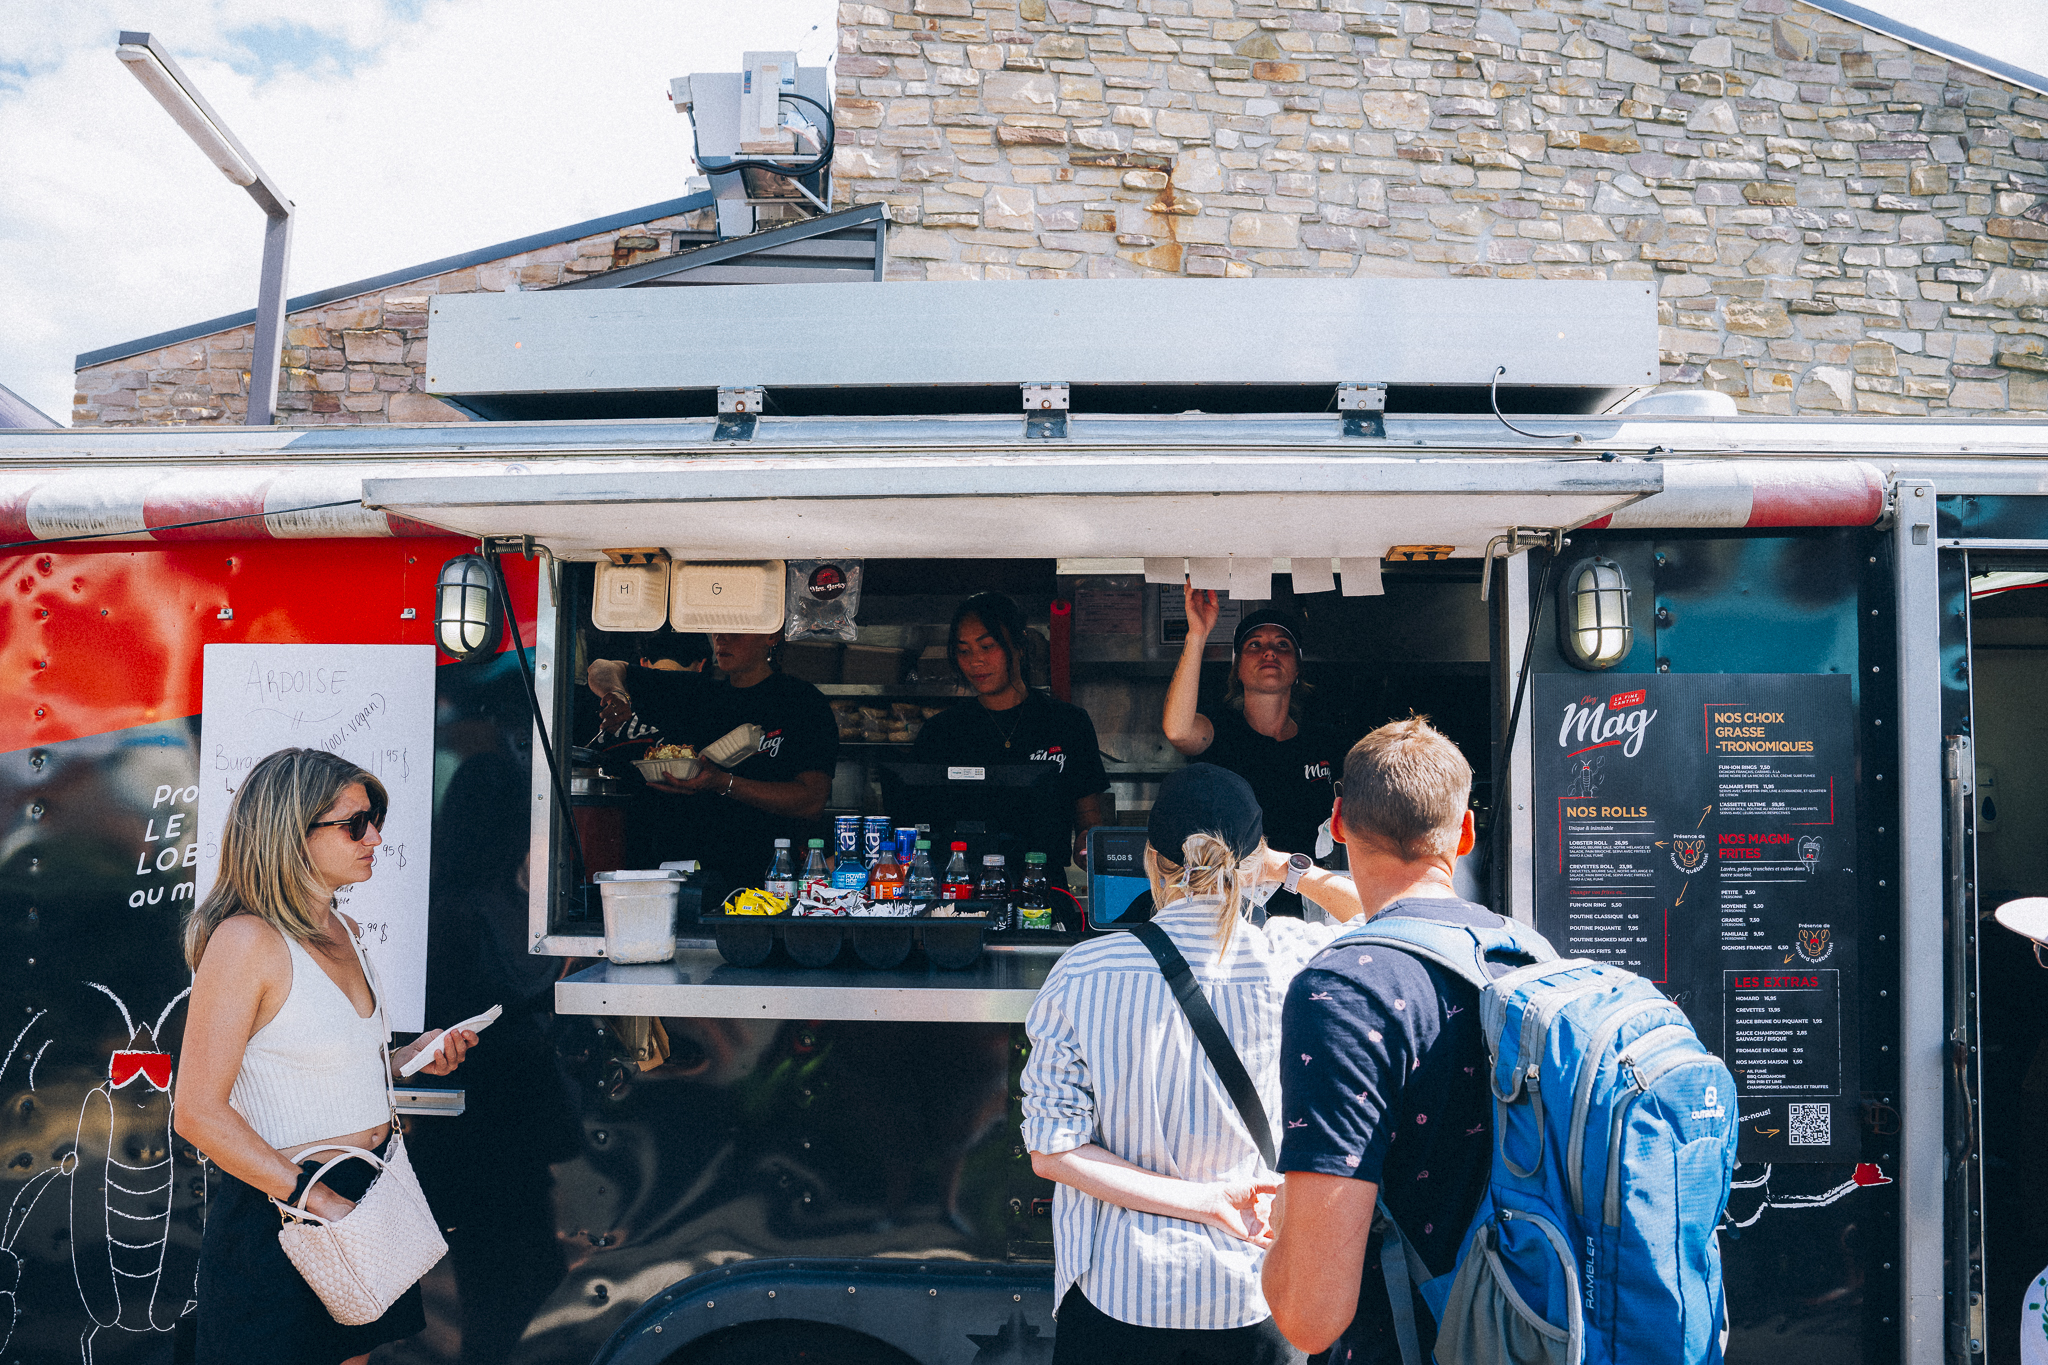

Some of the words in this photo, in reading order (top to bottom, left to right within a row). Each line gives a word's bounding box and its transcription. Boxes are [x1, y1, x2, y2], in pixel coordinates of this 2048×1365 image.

[621, 584, 629, 594] H
[712, 583, 722, 595] G
[246, 660, 349, 703] ARDOISE
[1715, 713, 1742, 723] NOS
[1744, 713, 1785, 723] CHOIX
[1559, 703, 1657, 757] Mag
[1715, 727, 1766, 737] GRASSE
[758, 735, 784, 757] ag
[1716, 741, 1814, 752] -TRONOMIQUES
[1567, 806, 1597, 818] NOS
[1602, 806, 1648, 818] ROLLS
[145, 814, 185, 842] LE
[1719, 834, 1745, 844] NOS
[1749, 834, 1794, 844] MAGNI-
[1719, 848, 1761, 858] FRITES
[129, 887, 164, 908] au
[1735, 977, 1760, 987] LES
[1764, 977, 1819, 987] EXTRAS
[1586, 1236, 1596, 1309] RAMBLER
